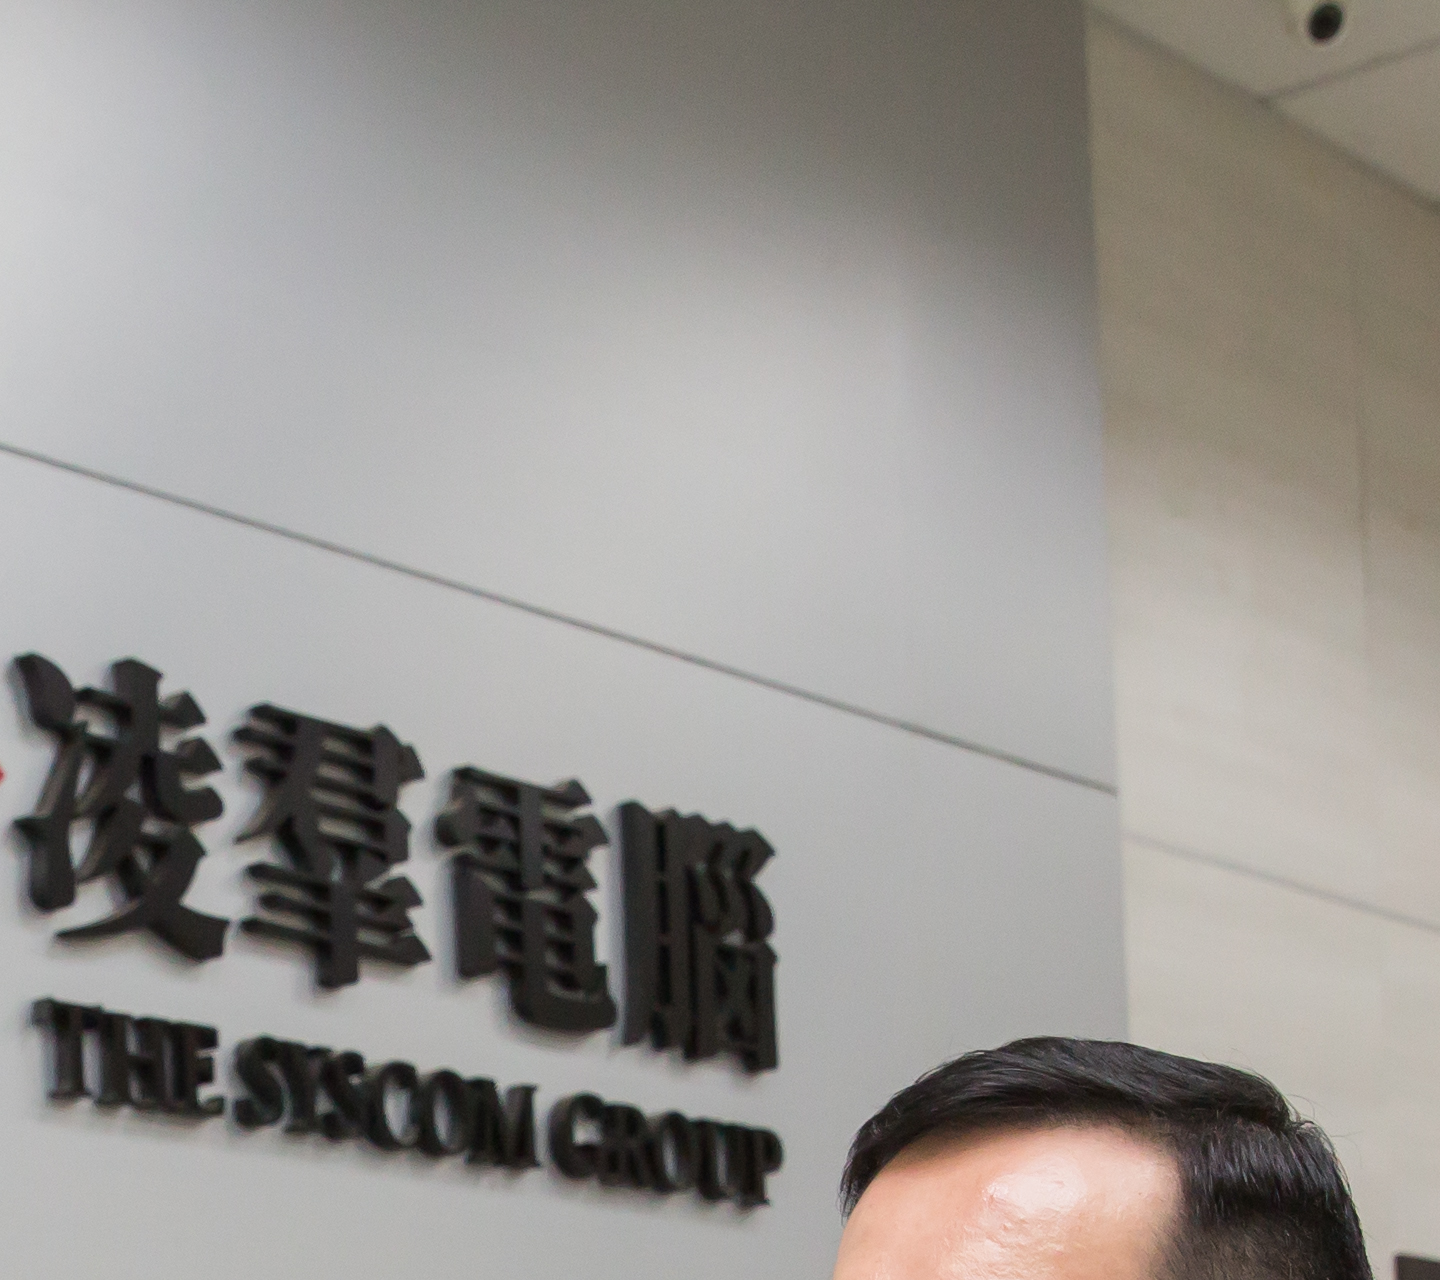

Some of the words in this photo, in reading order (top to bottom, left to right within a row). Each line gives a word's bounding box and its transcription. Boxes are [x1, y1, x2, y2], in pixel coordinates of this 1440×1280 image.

[32, 998, 224, 1116] THE
[232, 1036, 540, 1169] SYSCOM
[549, 1093, 784, 1206] GROUP
